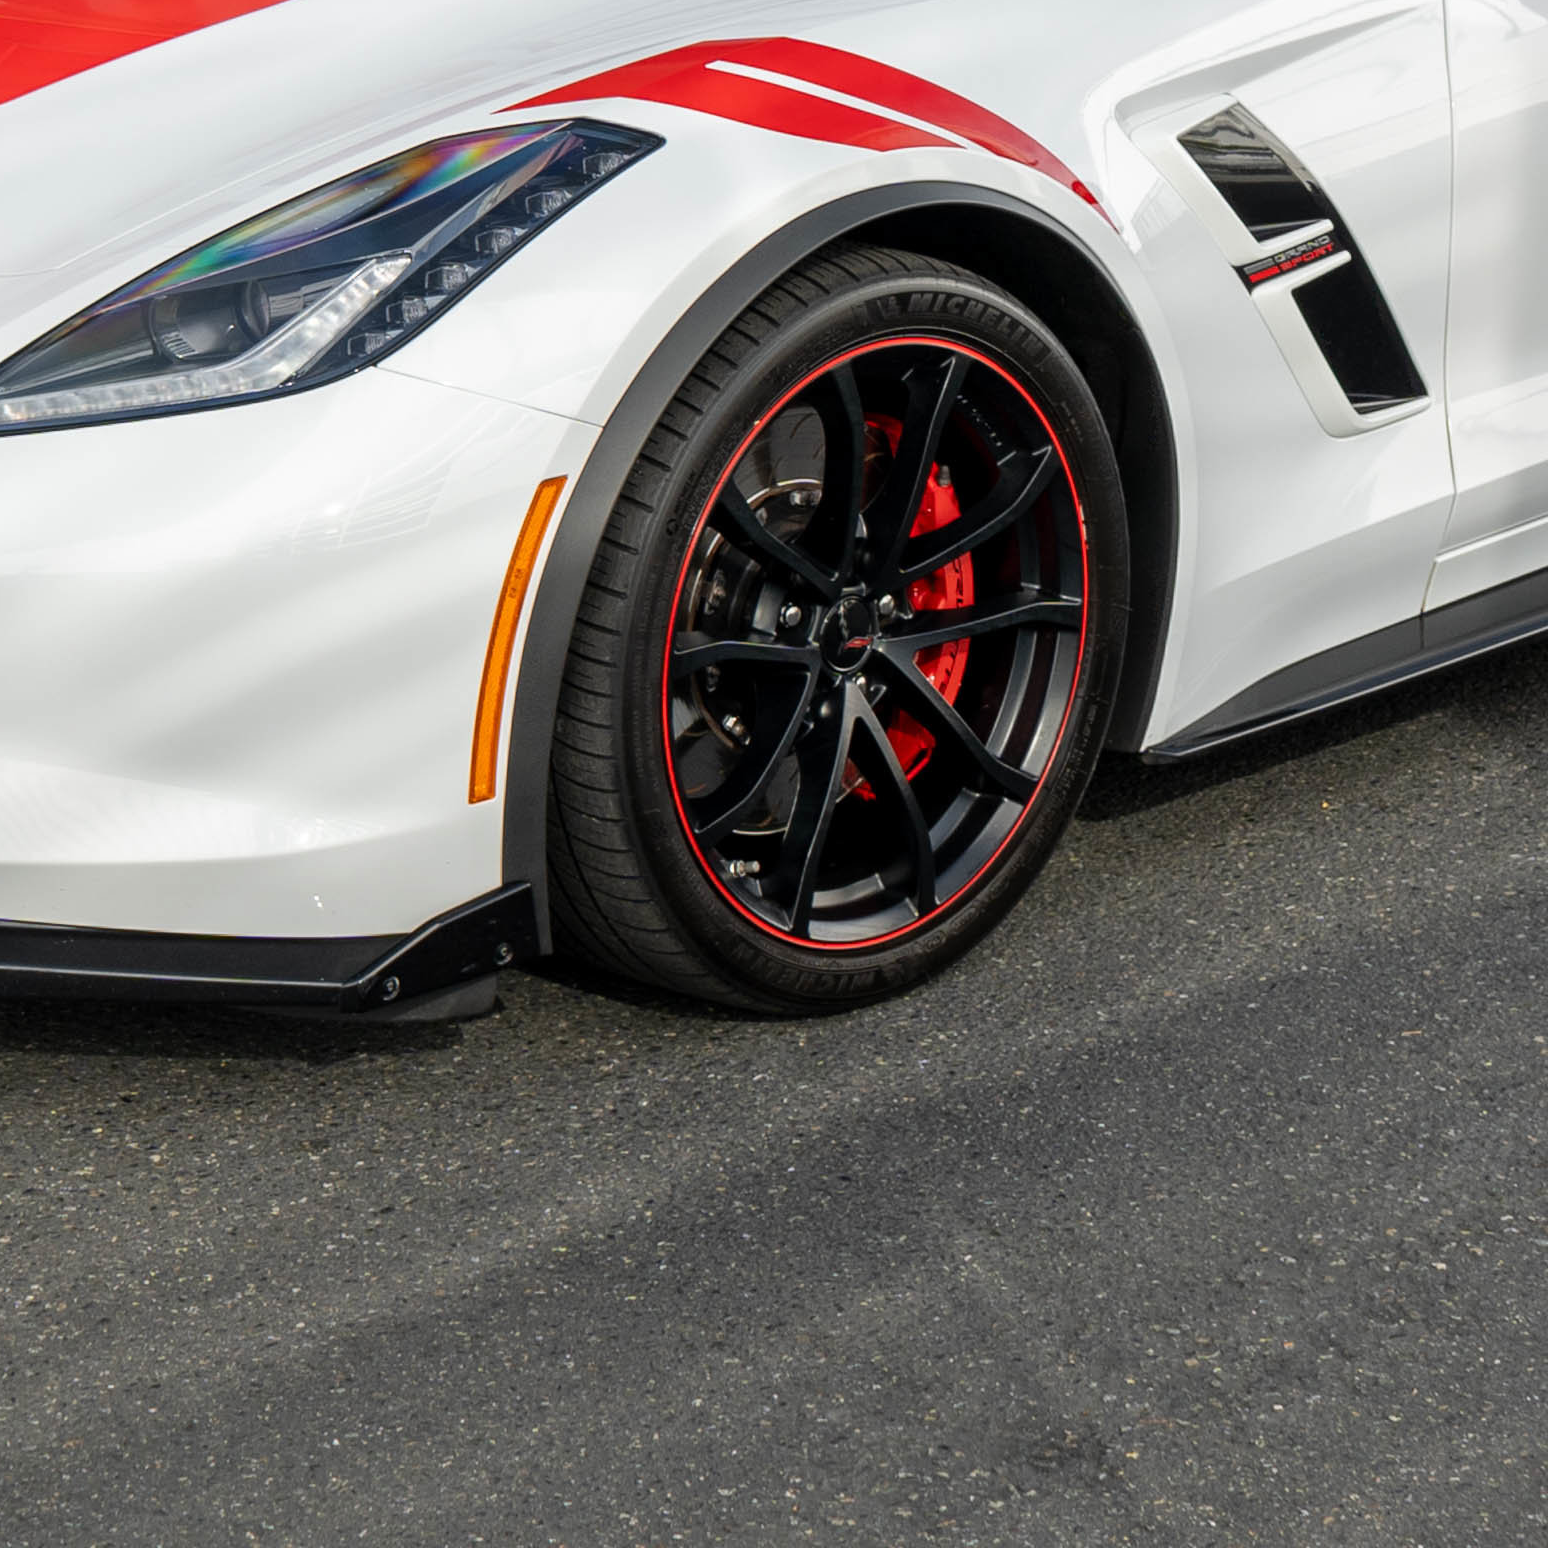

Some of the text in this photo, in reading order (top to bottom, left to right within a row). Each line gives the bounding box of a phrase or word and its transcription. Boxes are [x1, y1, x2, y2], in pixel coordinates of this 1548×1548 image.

[1274, 235, 1331, 263] GRAND
[1279, 242, 1335, 272] SPORT
[906, 292, 1050, 357] MICHELIN
